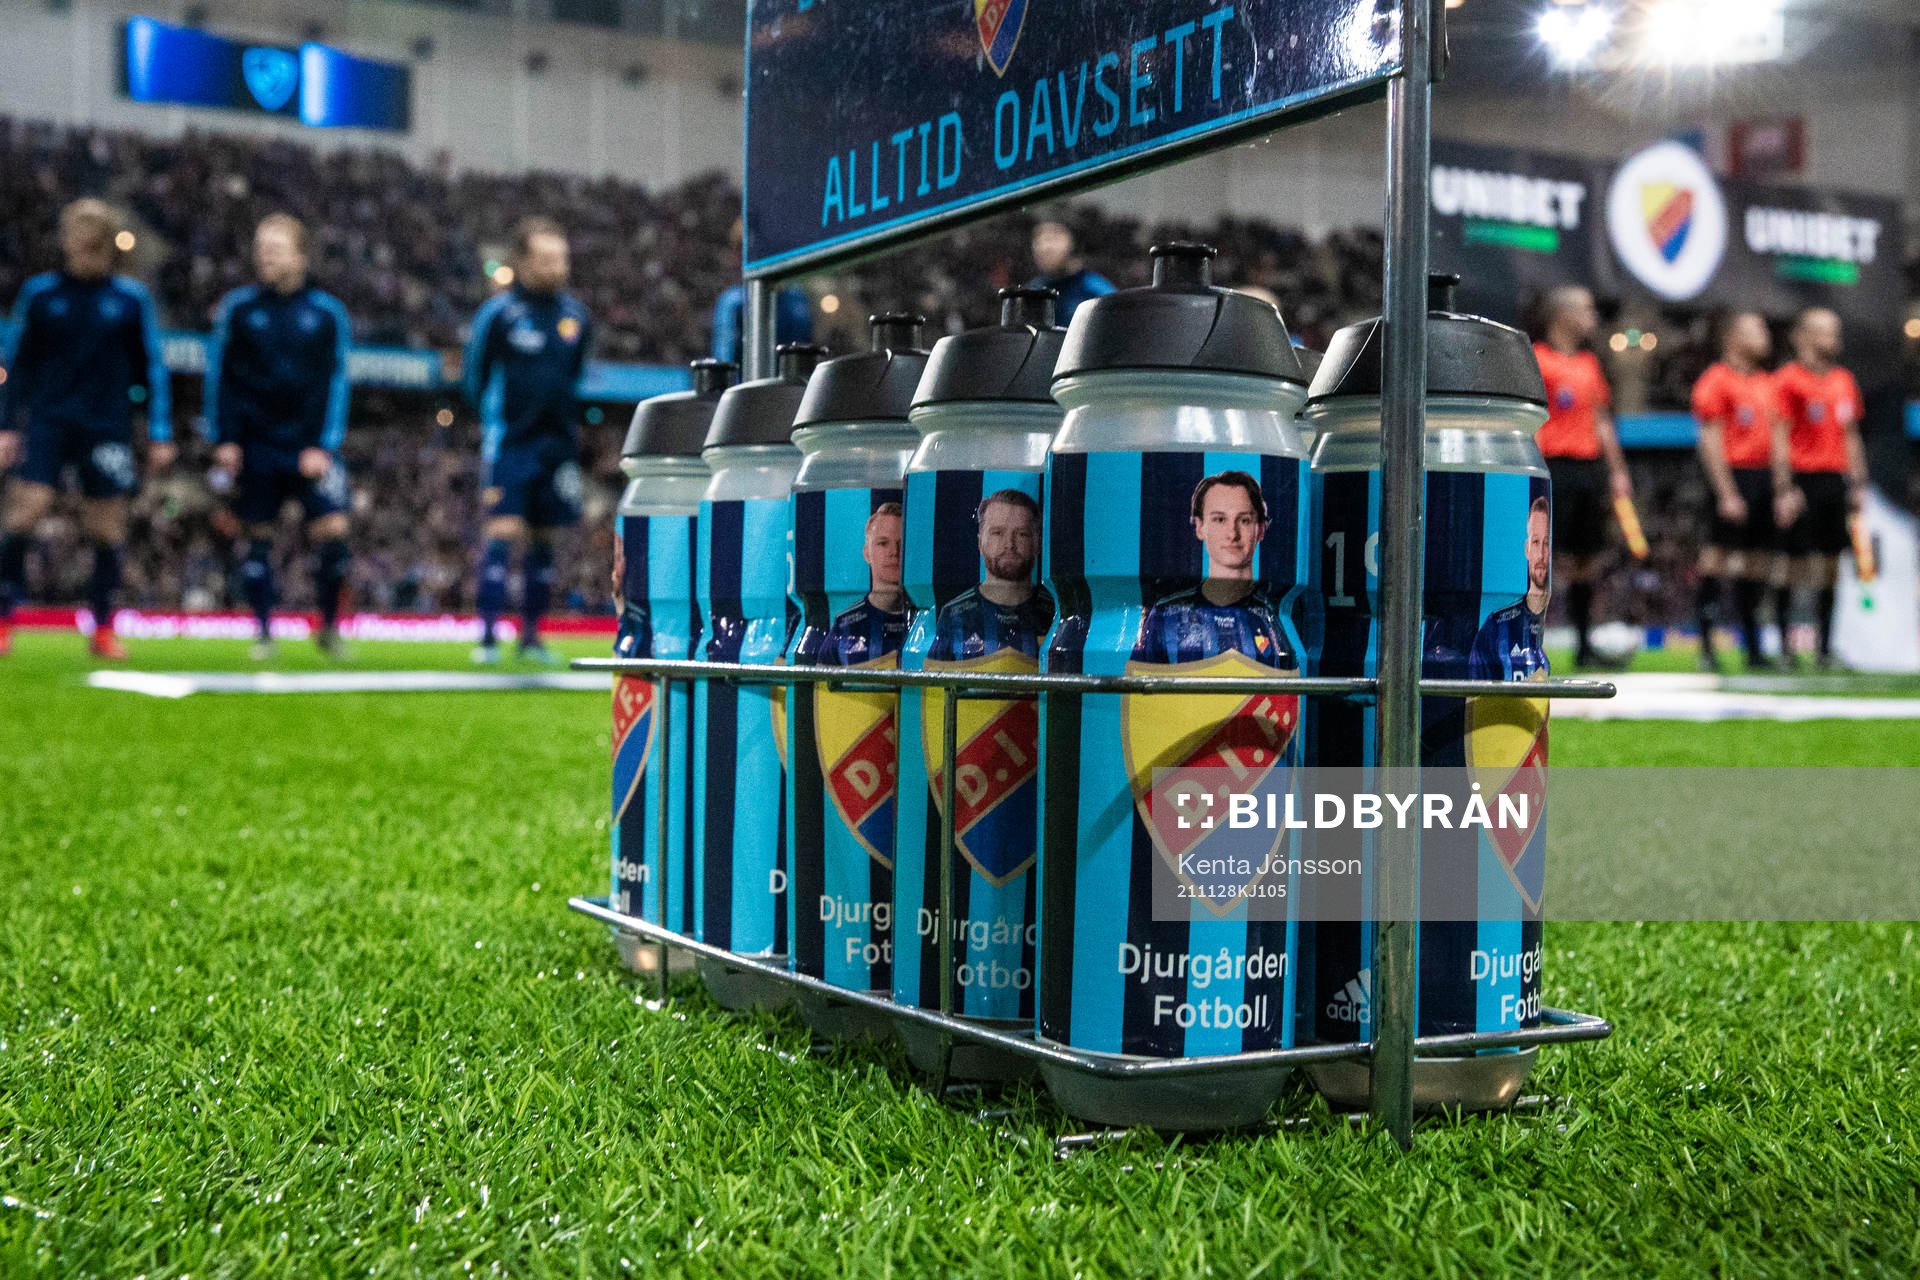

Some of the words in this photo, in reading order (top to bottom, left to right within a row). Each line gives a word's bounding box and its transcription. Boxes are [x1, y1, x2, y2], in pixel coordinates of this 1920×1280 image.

[821, 111, 962, 228] ALLTID
[994, 6, 1235, 169] OAVSETT
[1431, 165, 1587, 229] UNIBET
[1744, 206, 1881, 263] UNIBET
[1163, 697, 1290, 829] D.I.F.
[953, 956, 1032, 990] otbo
[1117, 942, 1290, 989] Djurgården
[1153, 994, 1268, 1030] Fotboll
